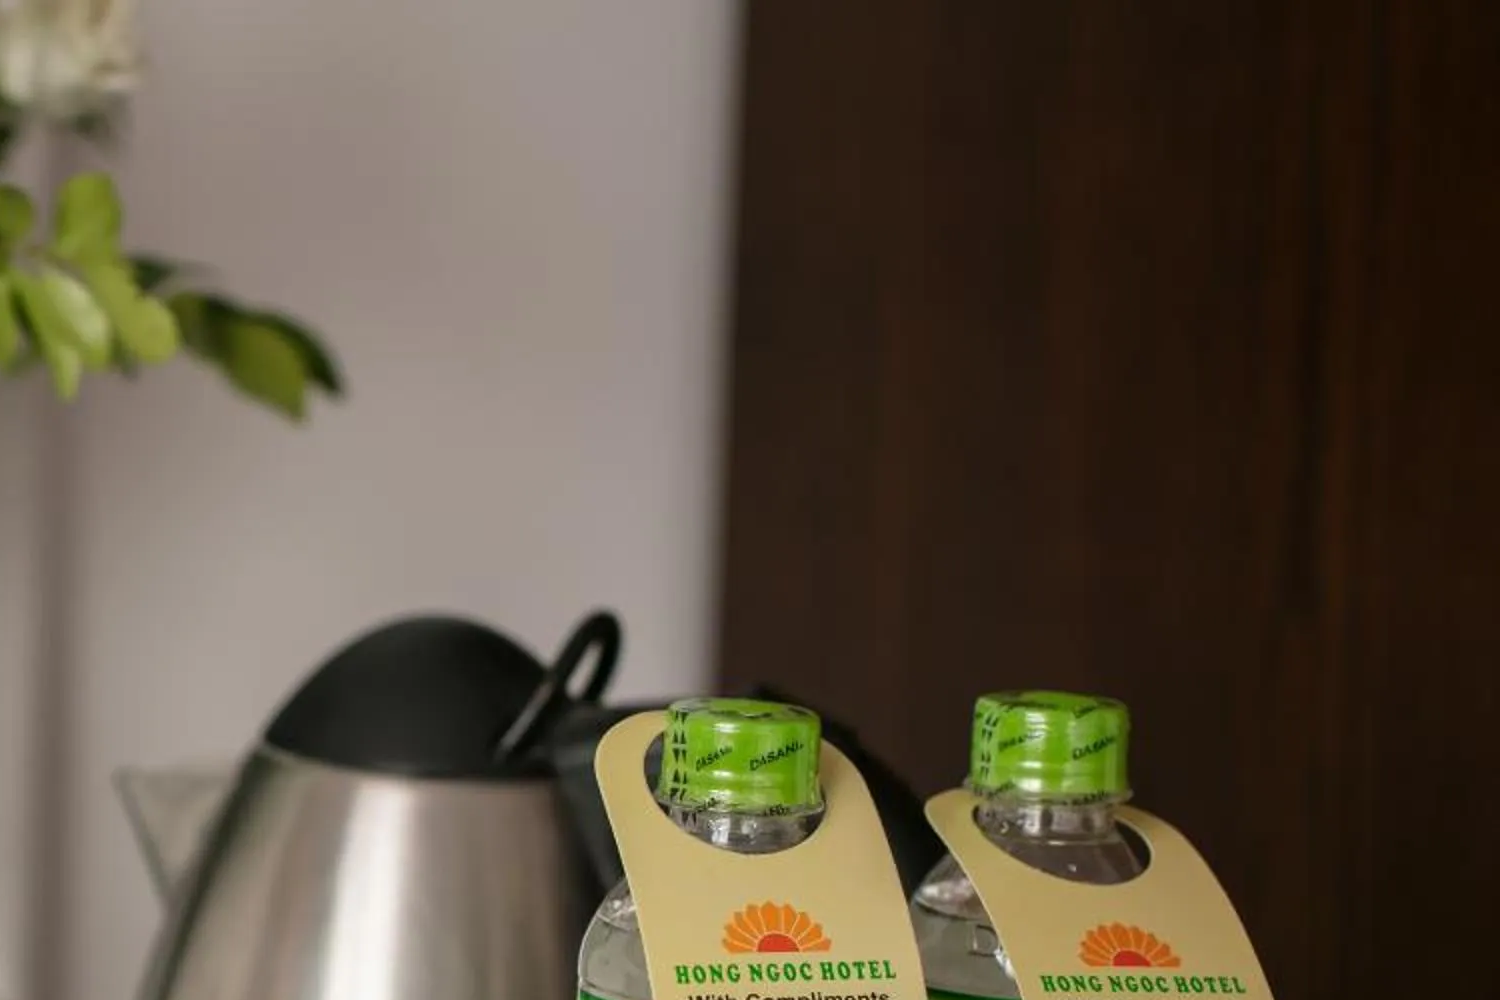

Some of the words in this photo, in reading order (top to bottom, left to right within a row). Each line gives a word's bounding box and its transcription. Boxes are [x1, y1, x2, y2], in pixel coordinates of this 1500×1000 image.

[674, 964, 741, 984] HONG
[748, 962, 813, 983] NGOC
[819, 960, 897, 981] HOTEL
[1040, 975, 1103, 993] HONG
[1107, 975, 1170, 993] NGOC
[1173, 976, 1247, 994] HOTEL
